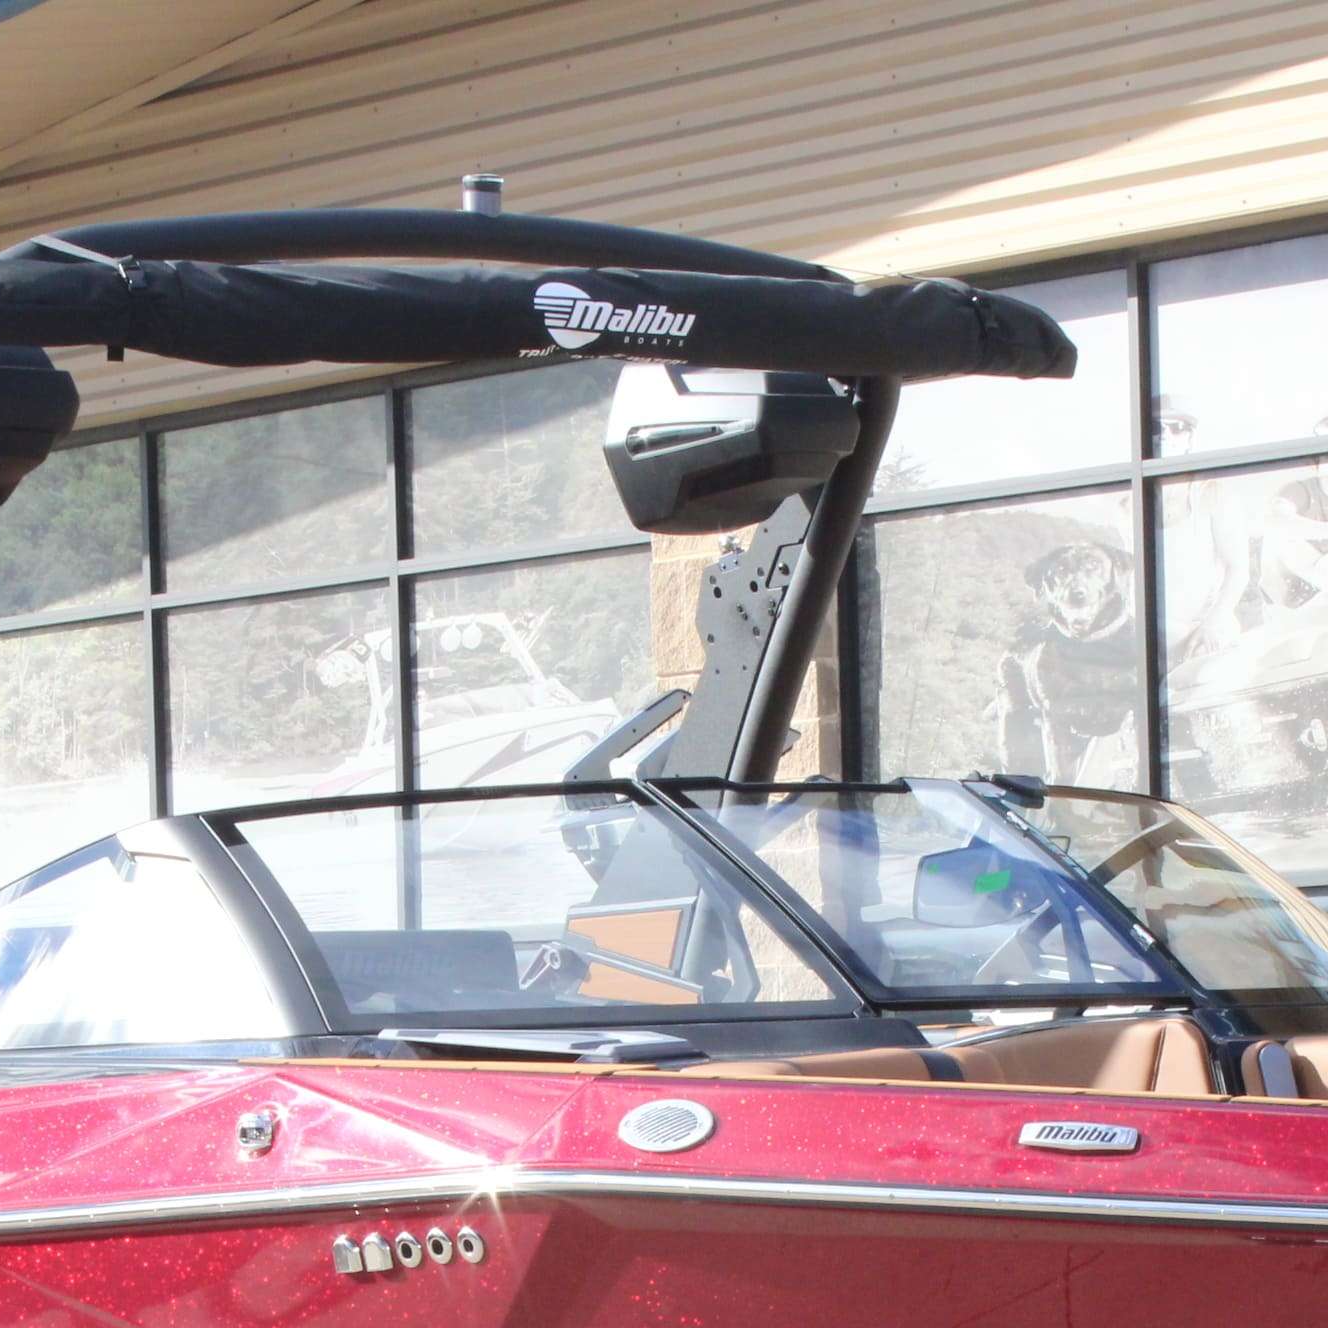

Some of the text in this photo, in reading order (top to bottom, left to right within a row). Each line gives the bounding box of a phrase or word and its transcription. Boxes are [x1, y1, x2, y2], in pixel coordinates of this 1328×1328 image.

[567, 299, 697, 337] Malibu
[624, 335, 684, 348] BOATS
[1035, 1124, 1118, 1143] Malibu
